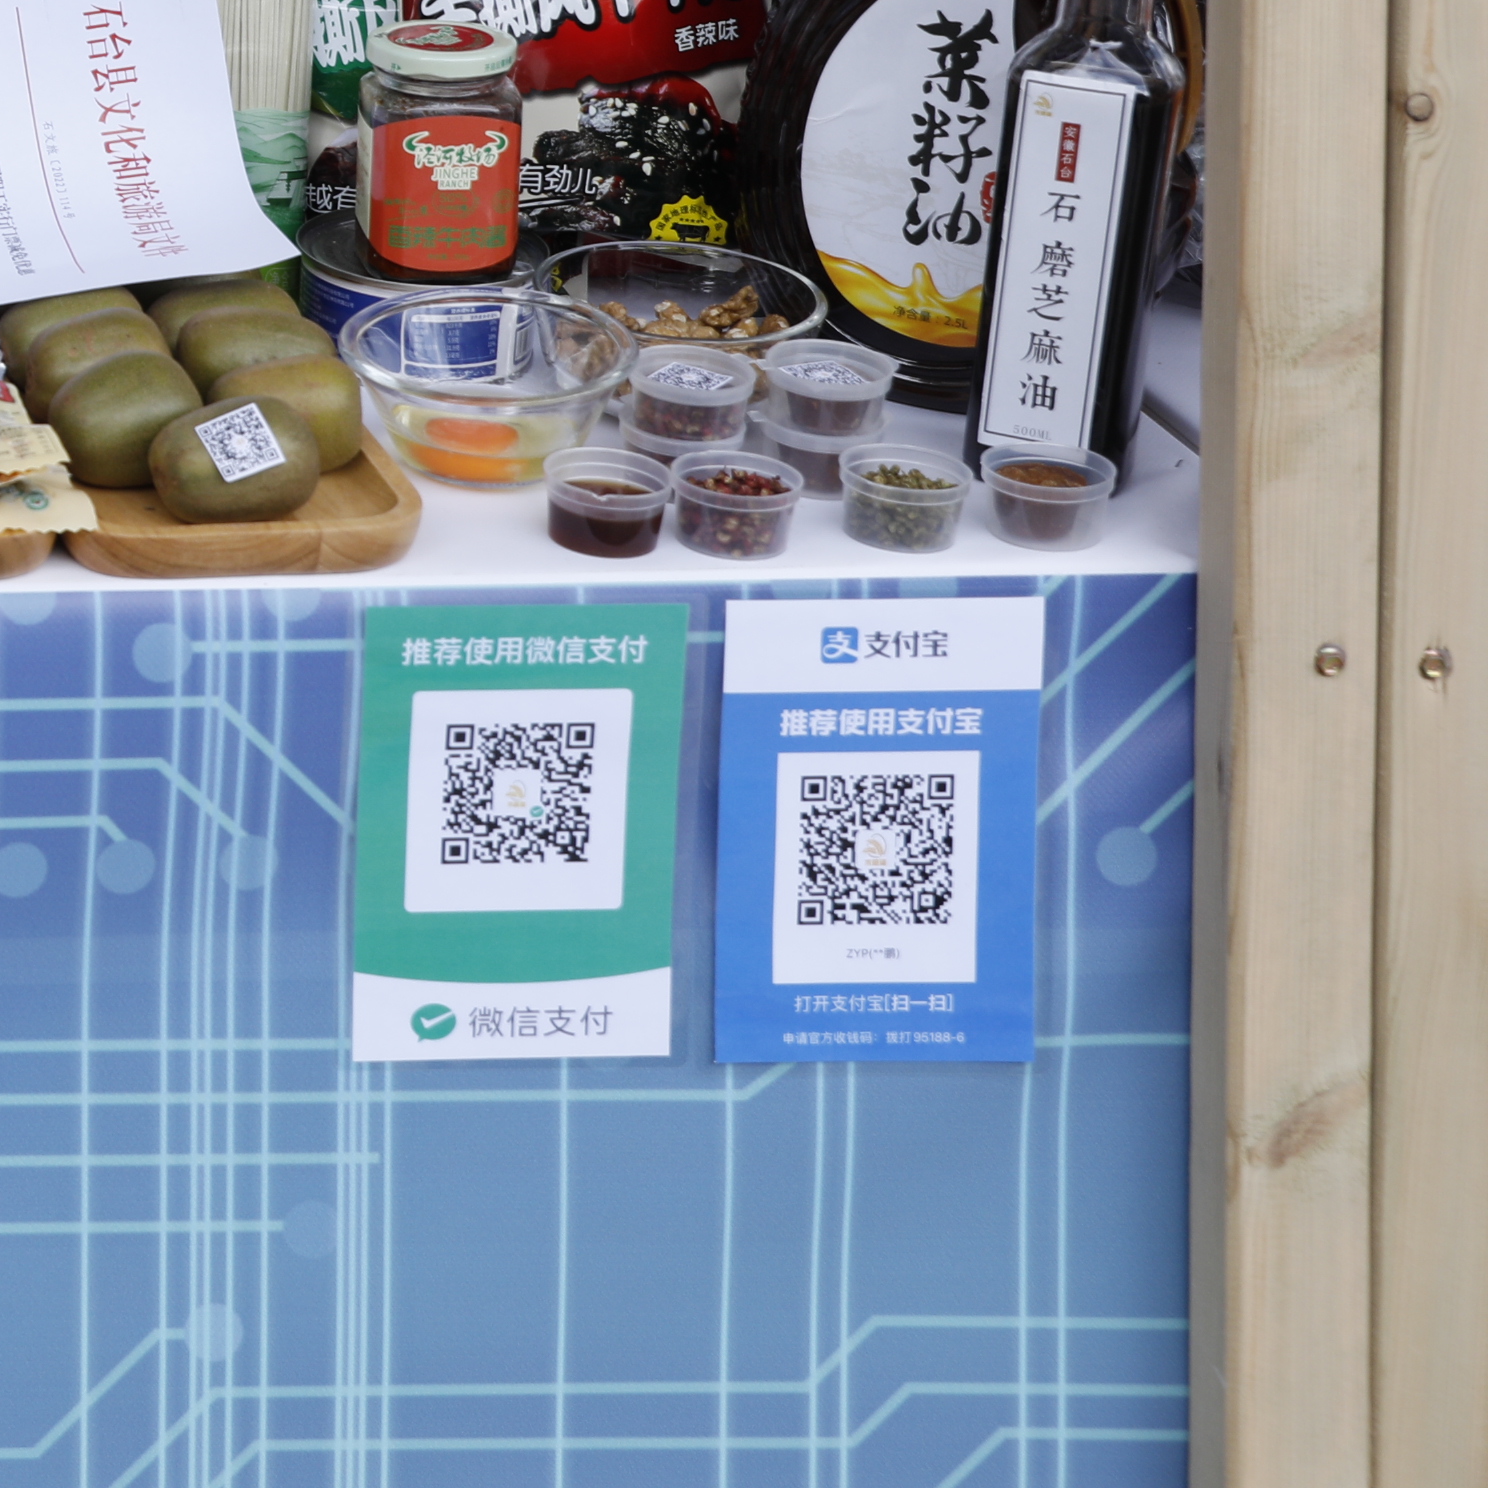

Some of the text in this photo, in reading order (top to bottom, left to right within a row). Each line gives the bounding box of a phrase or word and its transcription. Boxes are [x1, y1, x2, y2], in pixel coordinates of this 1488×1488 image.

[674, 19, 740, 55] 香辣味
[83, 1, 188, 258] 石台县文化和旅游局文件
[904, 9, 999, 248] 菜籽油
[416, 145, 497, 167] 泾河牧场
[433, 168, 477, 179] JINGHE
[439, 180, 470, 188] RANCH
[1018, 191, 1082, 413] 石磨芝麻油
[1011, 423, 1051, 441] 500ML
[401, 635, 648, 668] 推荐使用微信支付
[863, 630, 949, 660] 支付宝
[779, 707, 983, 738] 推荐使用支付宝
[794, 992, 954, 1015] 打开支付宝[扫一扫]
[468, 1005, 613, 1039] 微信支付
